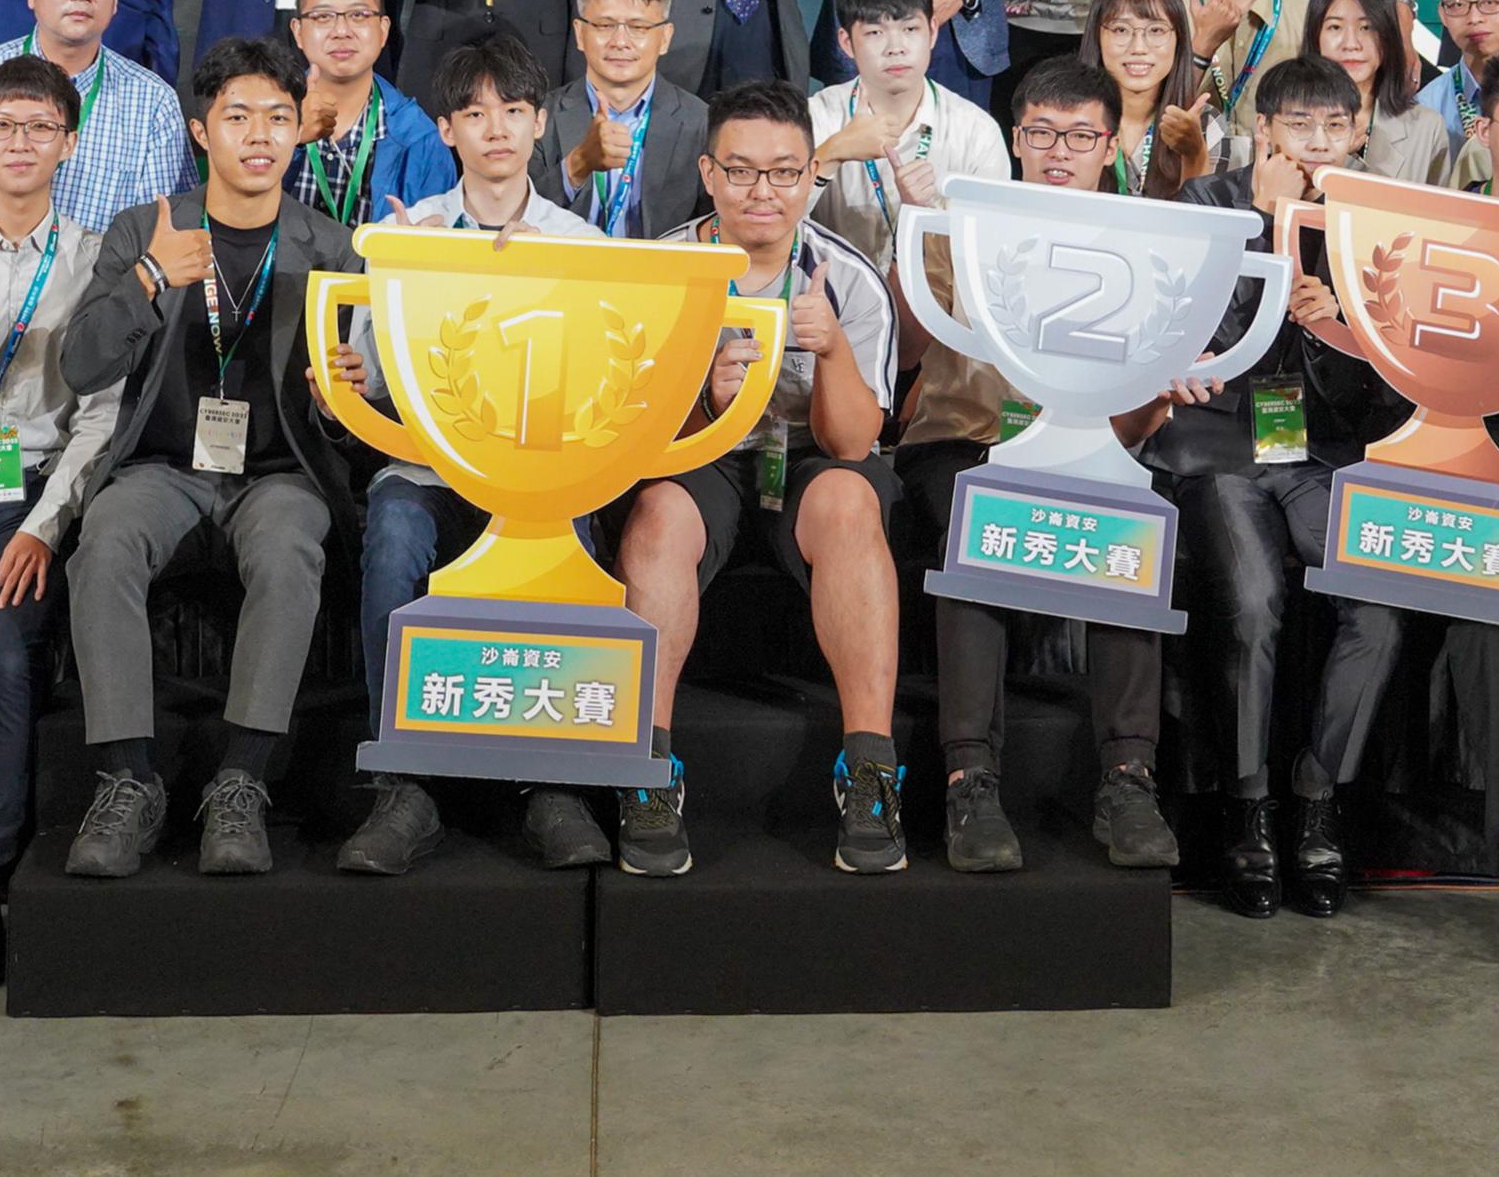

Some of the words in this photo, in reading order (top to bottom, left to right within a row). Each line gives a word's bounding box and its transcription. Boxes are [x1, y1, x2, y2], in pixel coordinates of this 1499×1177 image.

[1035, 242, 1135, 364] 2
[499, 310, 564, 451] 1
[1030, 508, 1098, 532] 沙崙資安
[1408, 506, 1474, 532] 沙崙資安
[981, 523, 1141, 581] 新秀大賽
[480, 646, 562, 669] 沙崙資安
[421, 672, 617, 727] 新秀大賽
